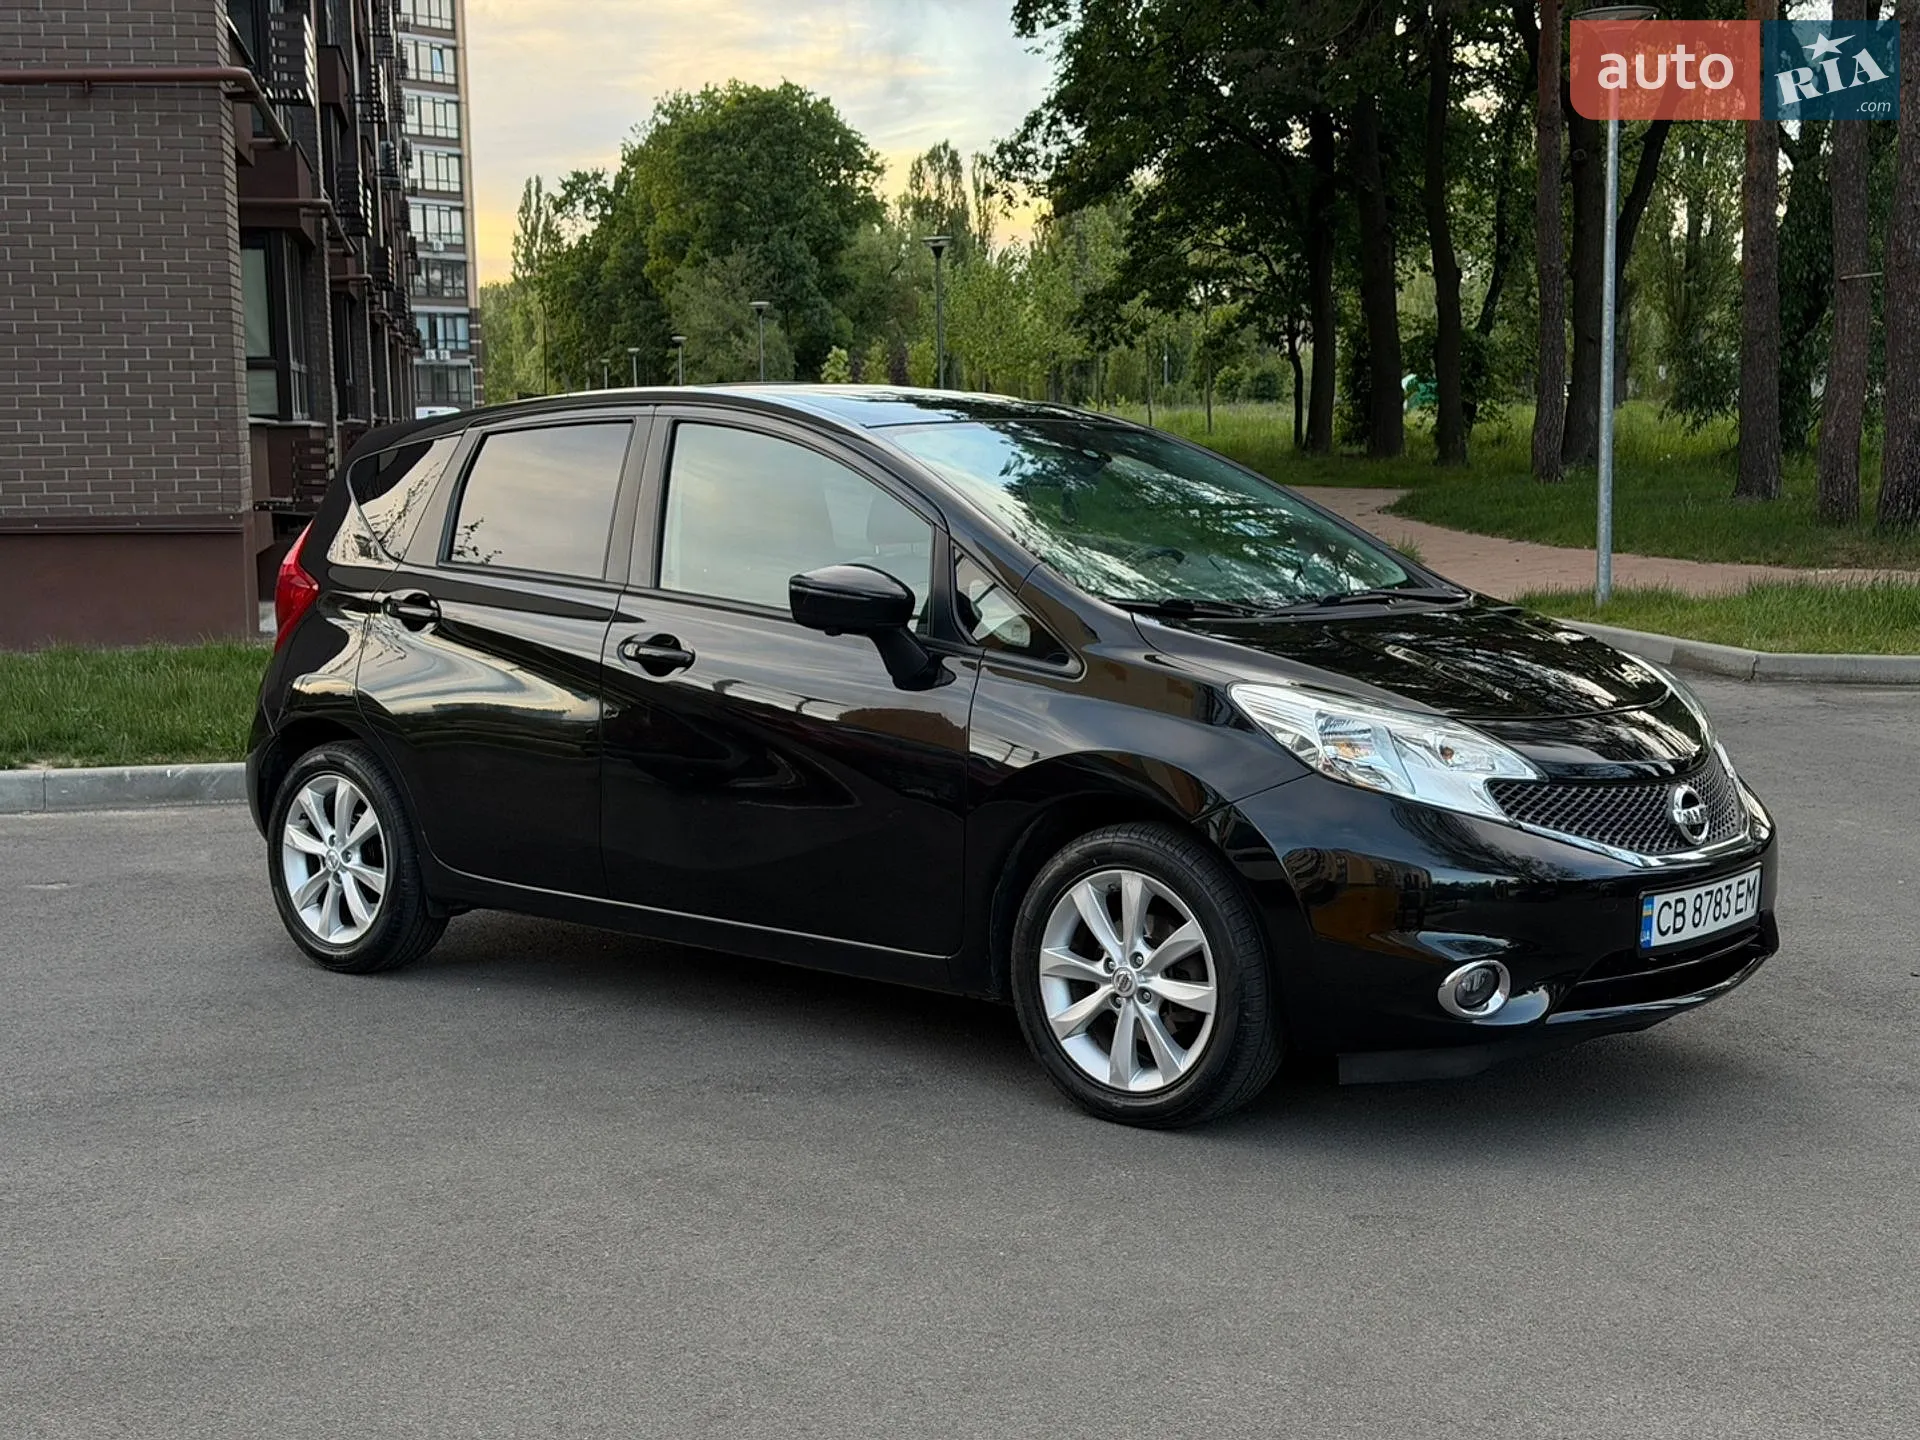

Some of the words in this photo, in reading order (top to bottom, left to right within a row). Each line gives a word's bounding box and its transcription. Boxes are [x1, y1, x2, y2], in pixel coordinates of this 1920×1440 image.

[1656, 897, 1687, 937] CB
[1692, 884, 1732, 929] 8783
[1734, 873, 1758, 916] EM
